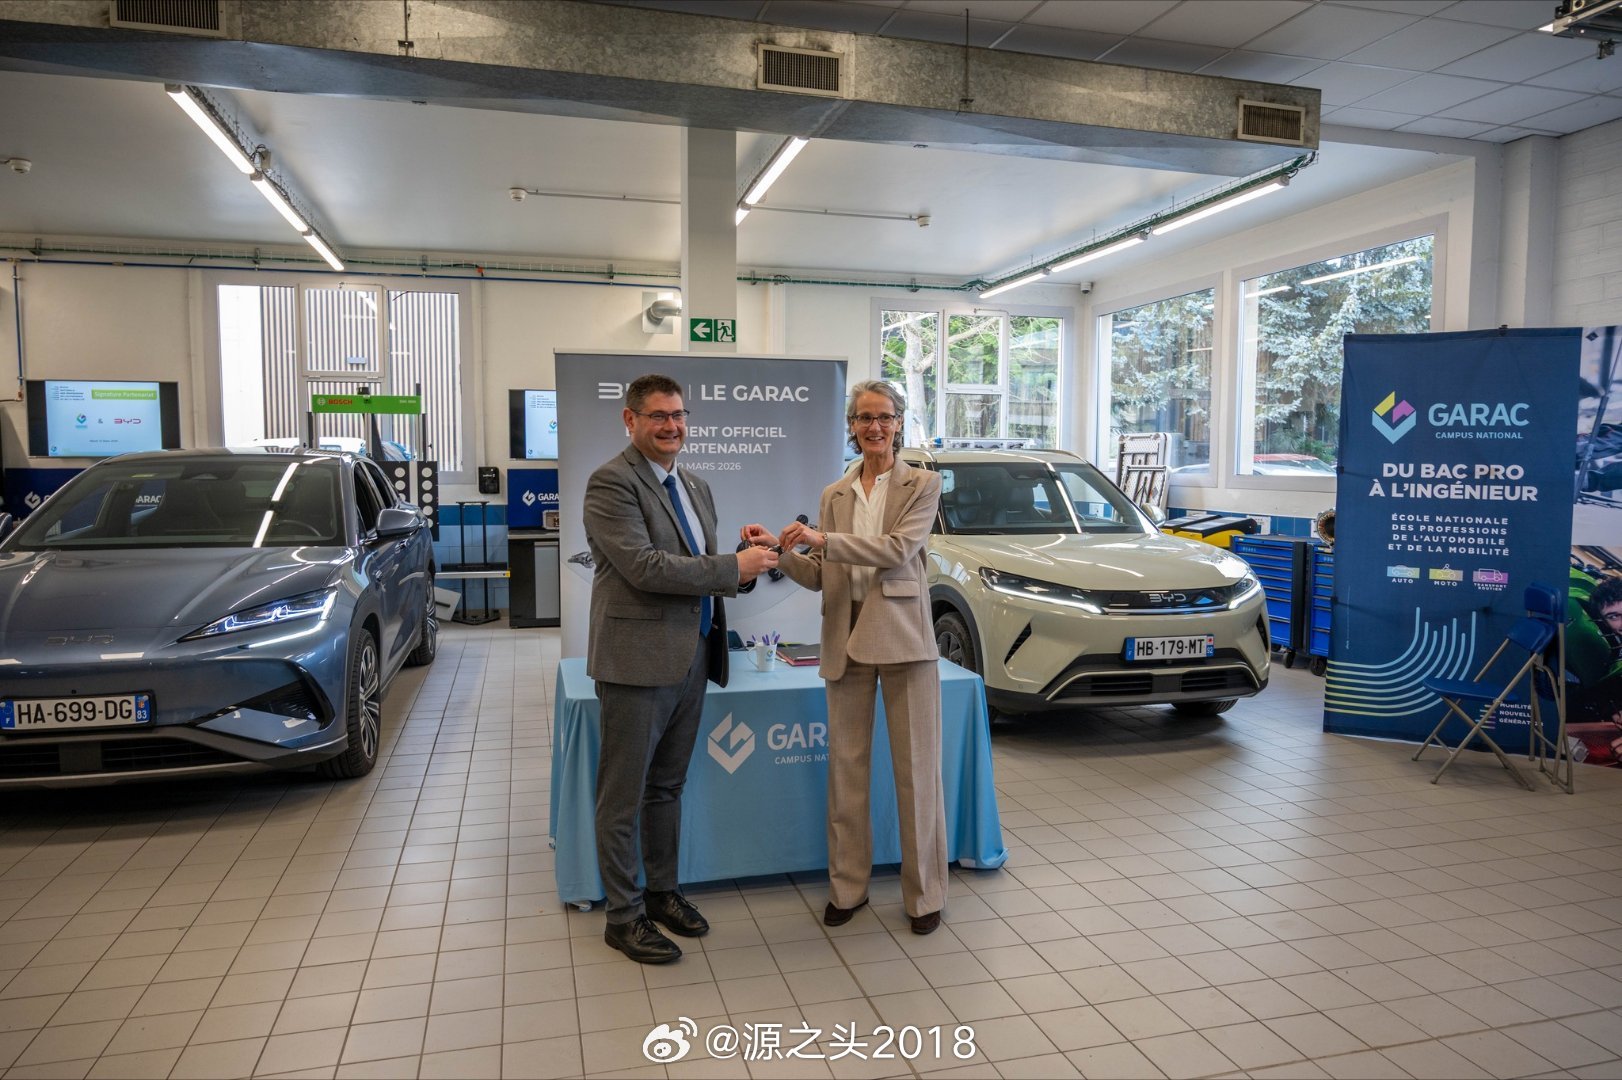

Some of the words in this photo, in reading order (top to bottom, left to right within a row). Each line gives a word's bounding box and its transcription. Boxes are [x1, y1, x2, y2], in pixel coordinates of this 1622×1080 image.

[94, 390, 121, 399] Signature
[122, 390, 154, 398] Partenariat
[700, 384, 726, 401] LE
[732, 384, 810, 402] GARAC
[1428, 402, 1530, 427] GARAC
[721, 426, 787, 438] OFFICIEL
[1435, 431, 1473, 439] CAMPUS
[1476, 431, 1523, 439] NATIONAL
[679, 443, 772, 454] ARTENARIAT
[686, 462, 716, 471] MARS
[718, 462, 742, 471] 2026
[1382, 463, 1414, 478] DU
[1420, 463, 1468, 479] BAC
[1474, 464, 1525, 480] PRO
[1368, 478, 1386, 497] À
[538, 492, 560, 501] GARA
[1391, 513, 1430, 522] ÉCOLE
[1435, 515, 1509, 525] NATIONALE
[1419, 525, 1508, 535] PROFESSIONS
[1393, 533, 1408, 541] DE
[1407, 544, 1422, 552] DE
[1428, 545, 1443, 553] LA
[1449, 546, 1510, 556] MOBILITÉ
[1149, 593, 1187, 603] BYD
[1136, 639, 1205, 656] HB-179-MT
[5, 717, 11, 725] F
[17, 699, 133, 725] HA-699-DG
[136, 710, 148, 720] 83
[1499, 710, 1532, 718] NOUVELL
[767, 722, 829, 751] GAR
[775, 754, 812, 765] CAMPUS
